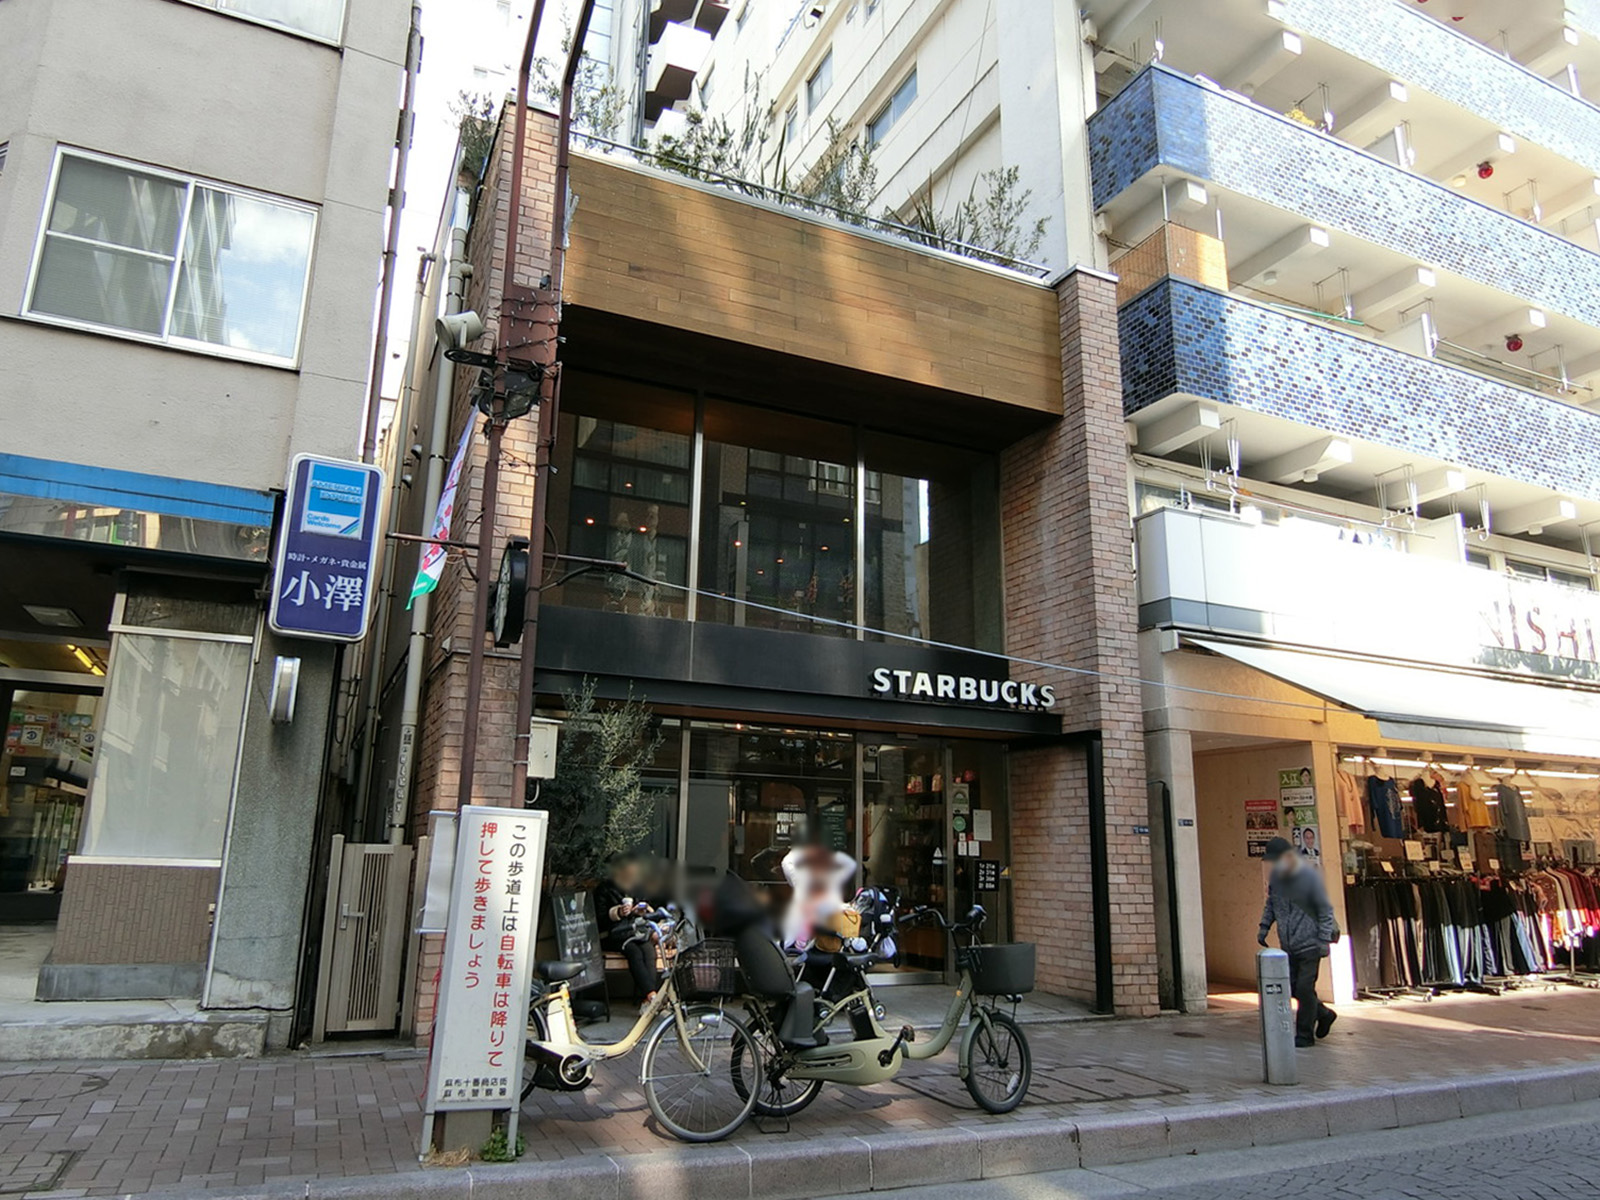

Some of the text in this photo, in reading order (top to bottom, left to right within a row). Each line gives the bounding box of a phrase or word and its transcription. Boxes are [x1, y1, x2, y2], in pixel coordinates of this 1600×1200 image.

[320, 490, 363, 504] EXPRESS
[307, 513, 330, 522] Cards
[307, 519, 342, 529] Welcome
[281, 570, 364, 612] 小澤
[873, 668, 1056, 707] STARBUCKS
[465, 822, 498, 988] 押して歩きましょう
[488, 824, 527, 1067] この歩道上は自転車は降りて
